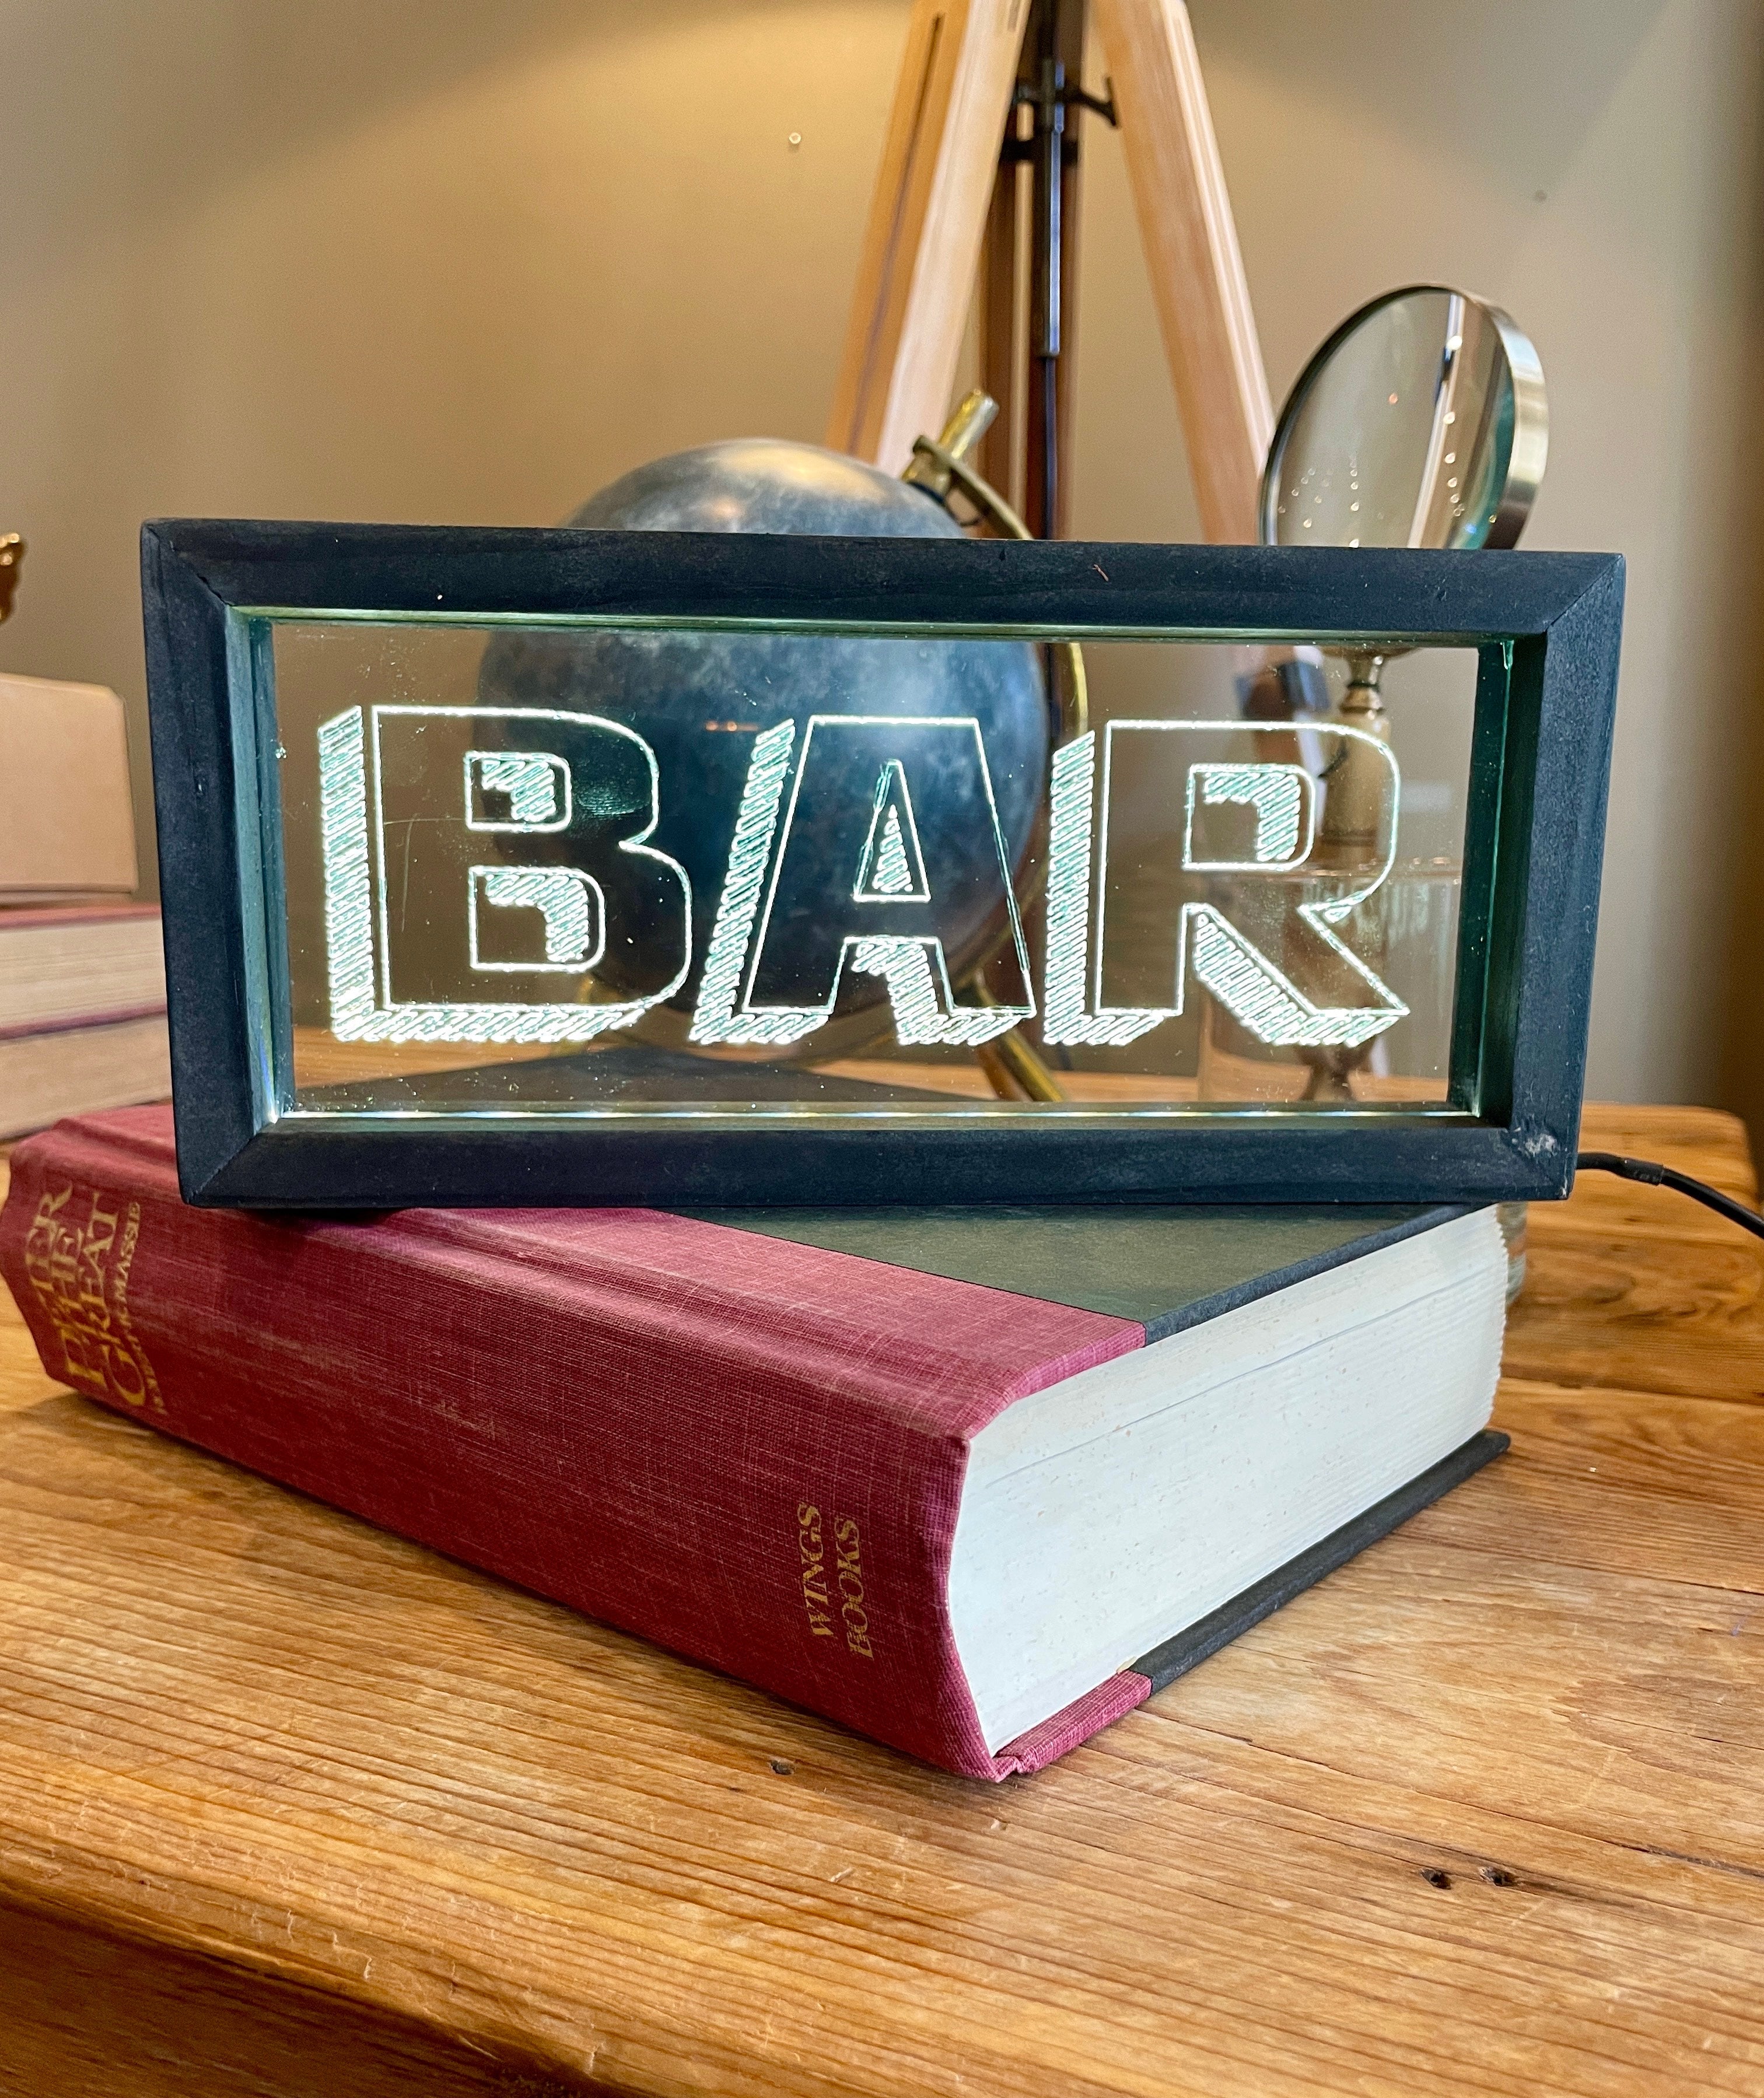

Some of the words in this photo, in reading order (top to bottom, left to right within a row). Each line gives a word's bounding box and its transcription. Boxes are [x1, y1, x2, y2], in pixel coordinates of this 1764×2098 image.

[317, 703, 1410, 1047] BAR
[26, 1181, 108, 1391] PETER
[50, 1227, 97, 1344] THE
[79, 1192, 145, 1405] GREAT
[114, 1202, 140, 1304] MASSIE
[797, 1502, 834, 1636] WINGS
[835, 1516, 874, 1661] BOOKS
